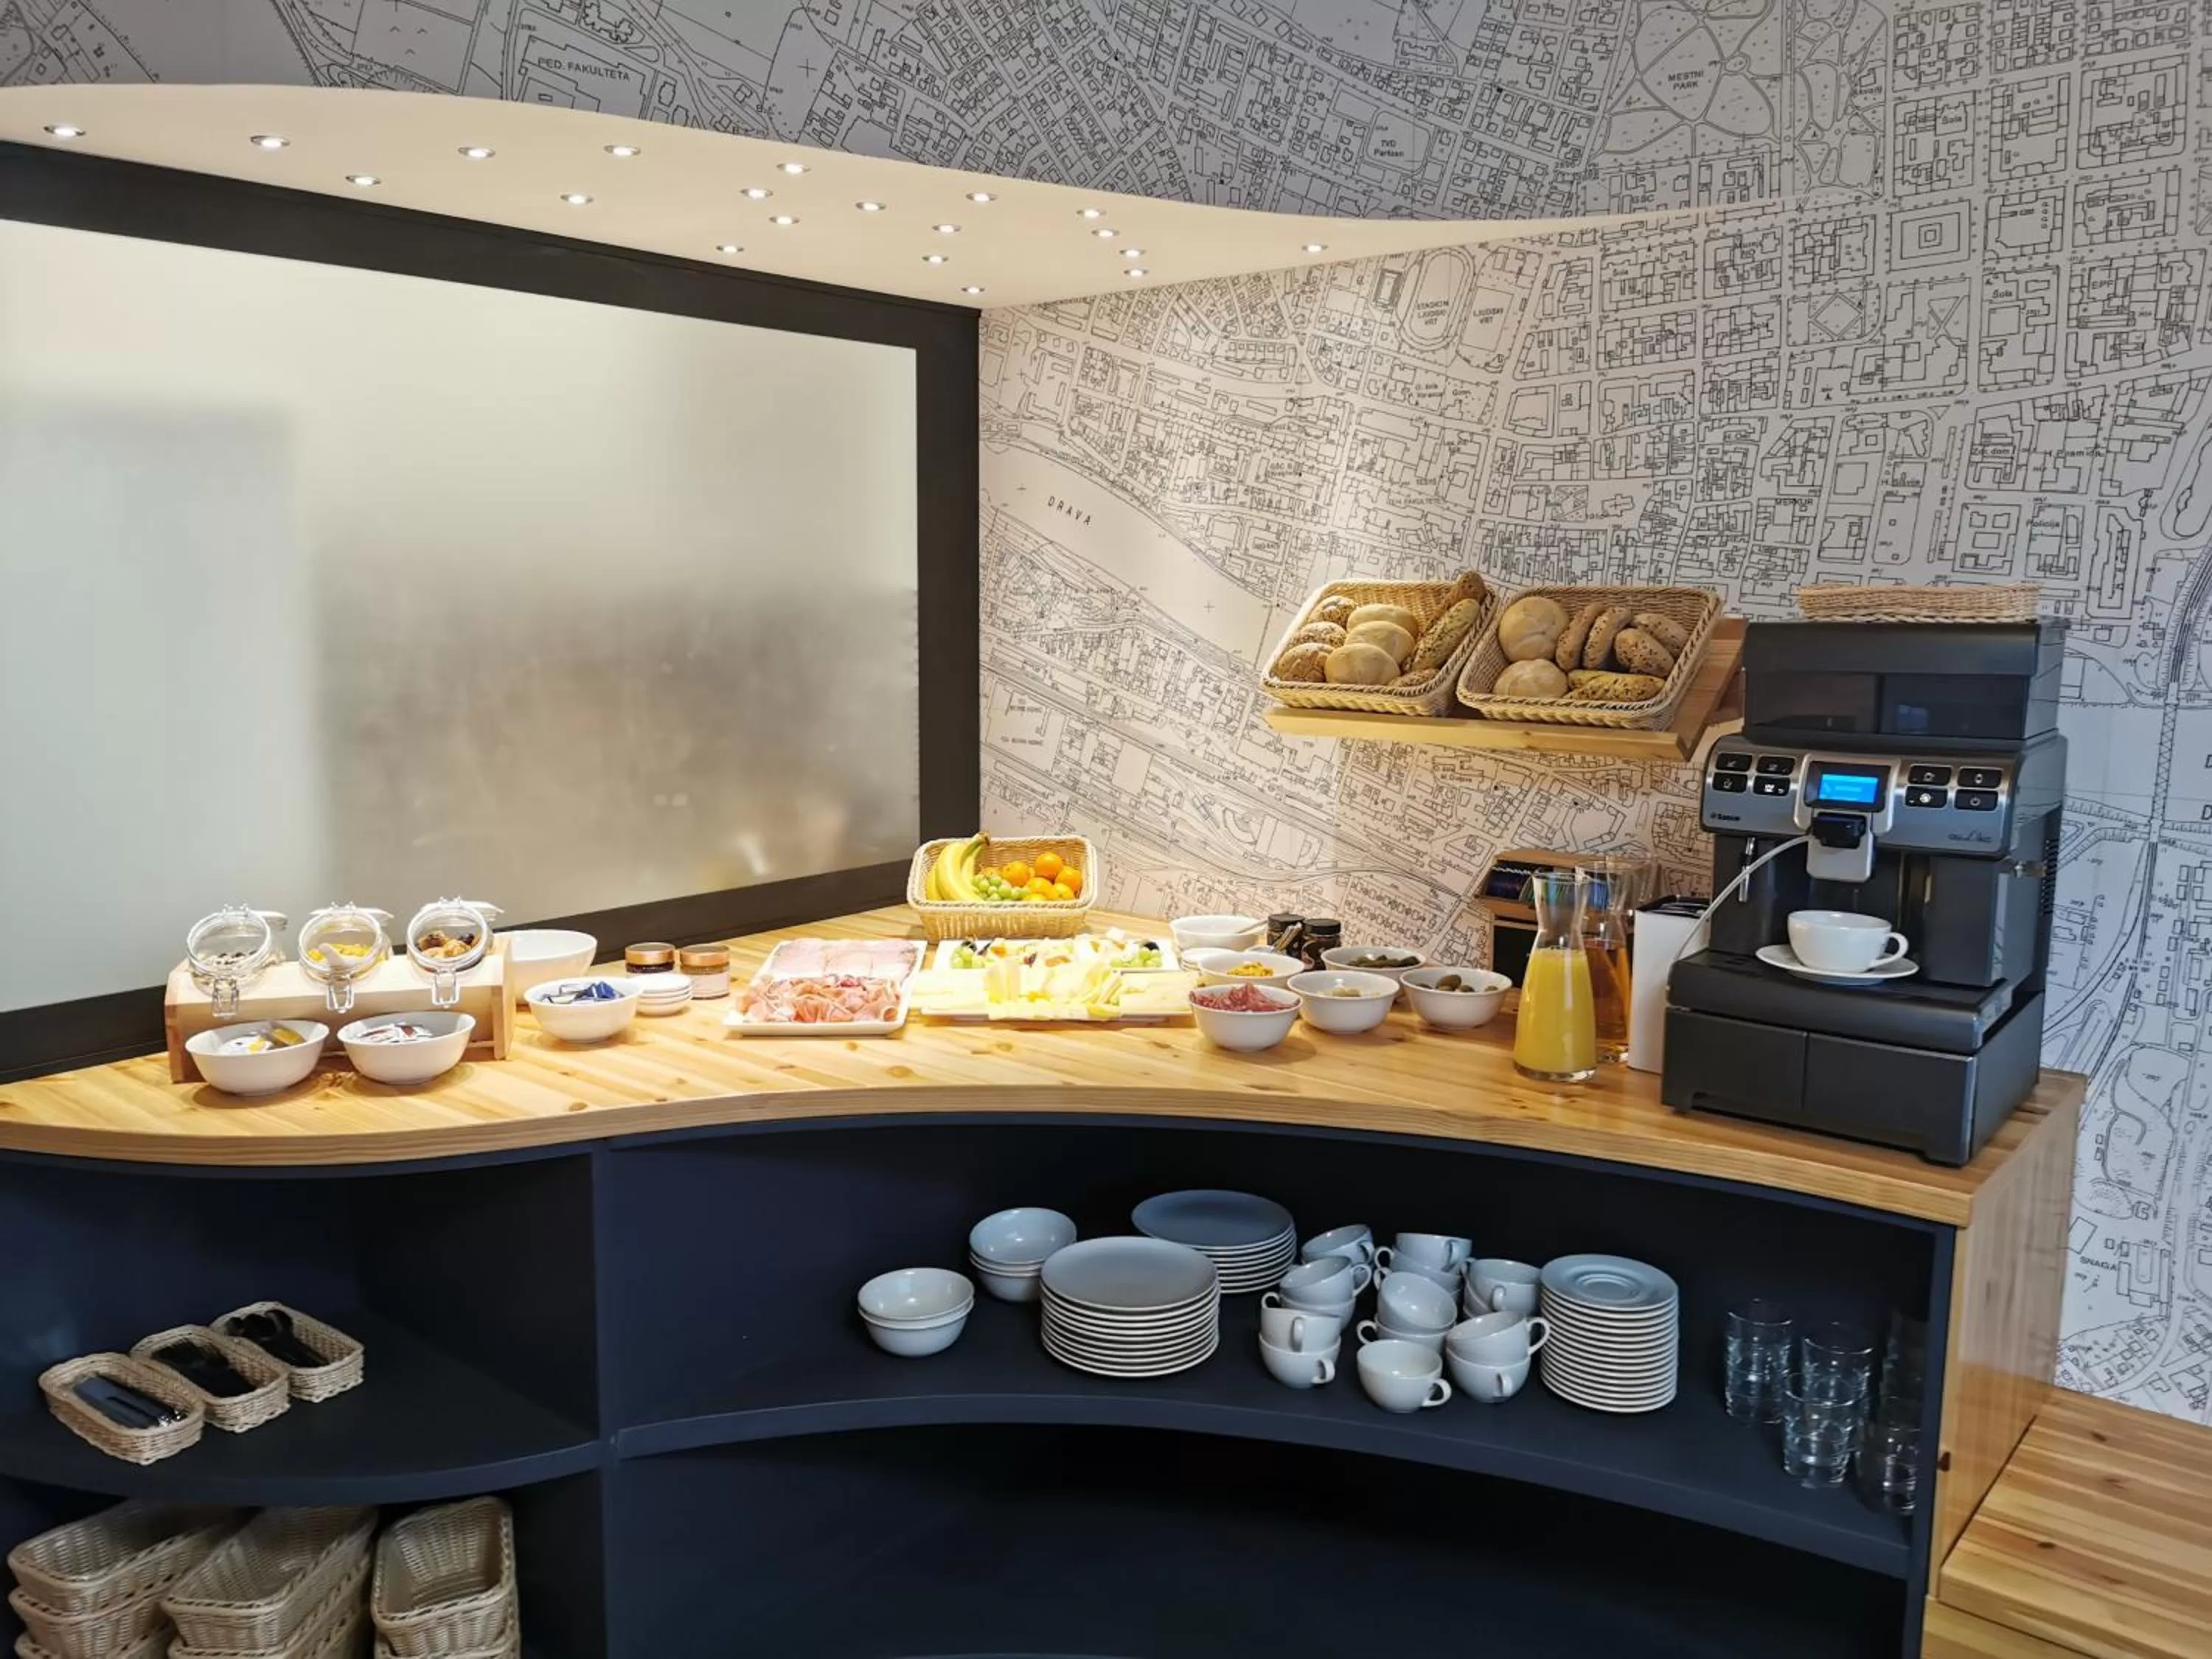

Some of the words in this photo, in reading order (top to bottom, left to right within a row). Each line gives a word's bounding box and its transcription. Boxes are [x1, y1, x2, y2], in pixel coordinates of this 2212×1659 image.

[538, 57, 566, 70] PED.
[567, 61, 630, 81] FAKULTETA
[1668, 70, 1704, 82] MESTNI
[1673, 80, 1699, 90] PARK
[1048, 495, 1091, 526] DRAVA
[2079, 1256, 2117, 1270] SNAGA
